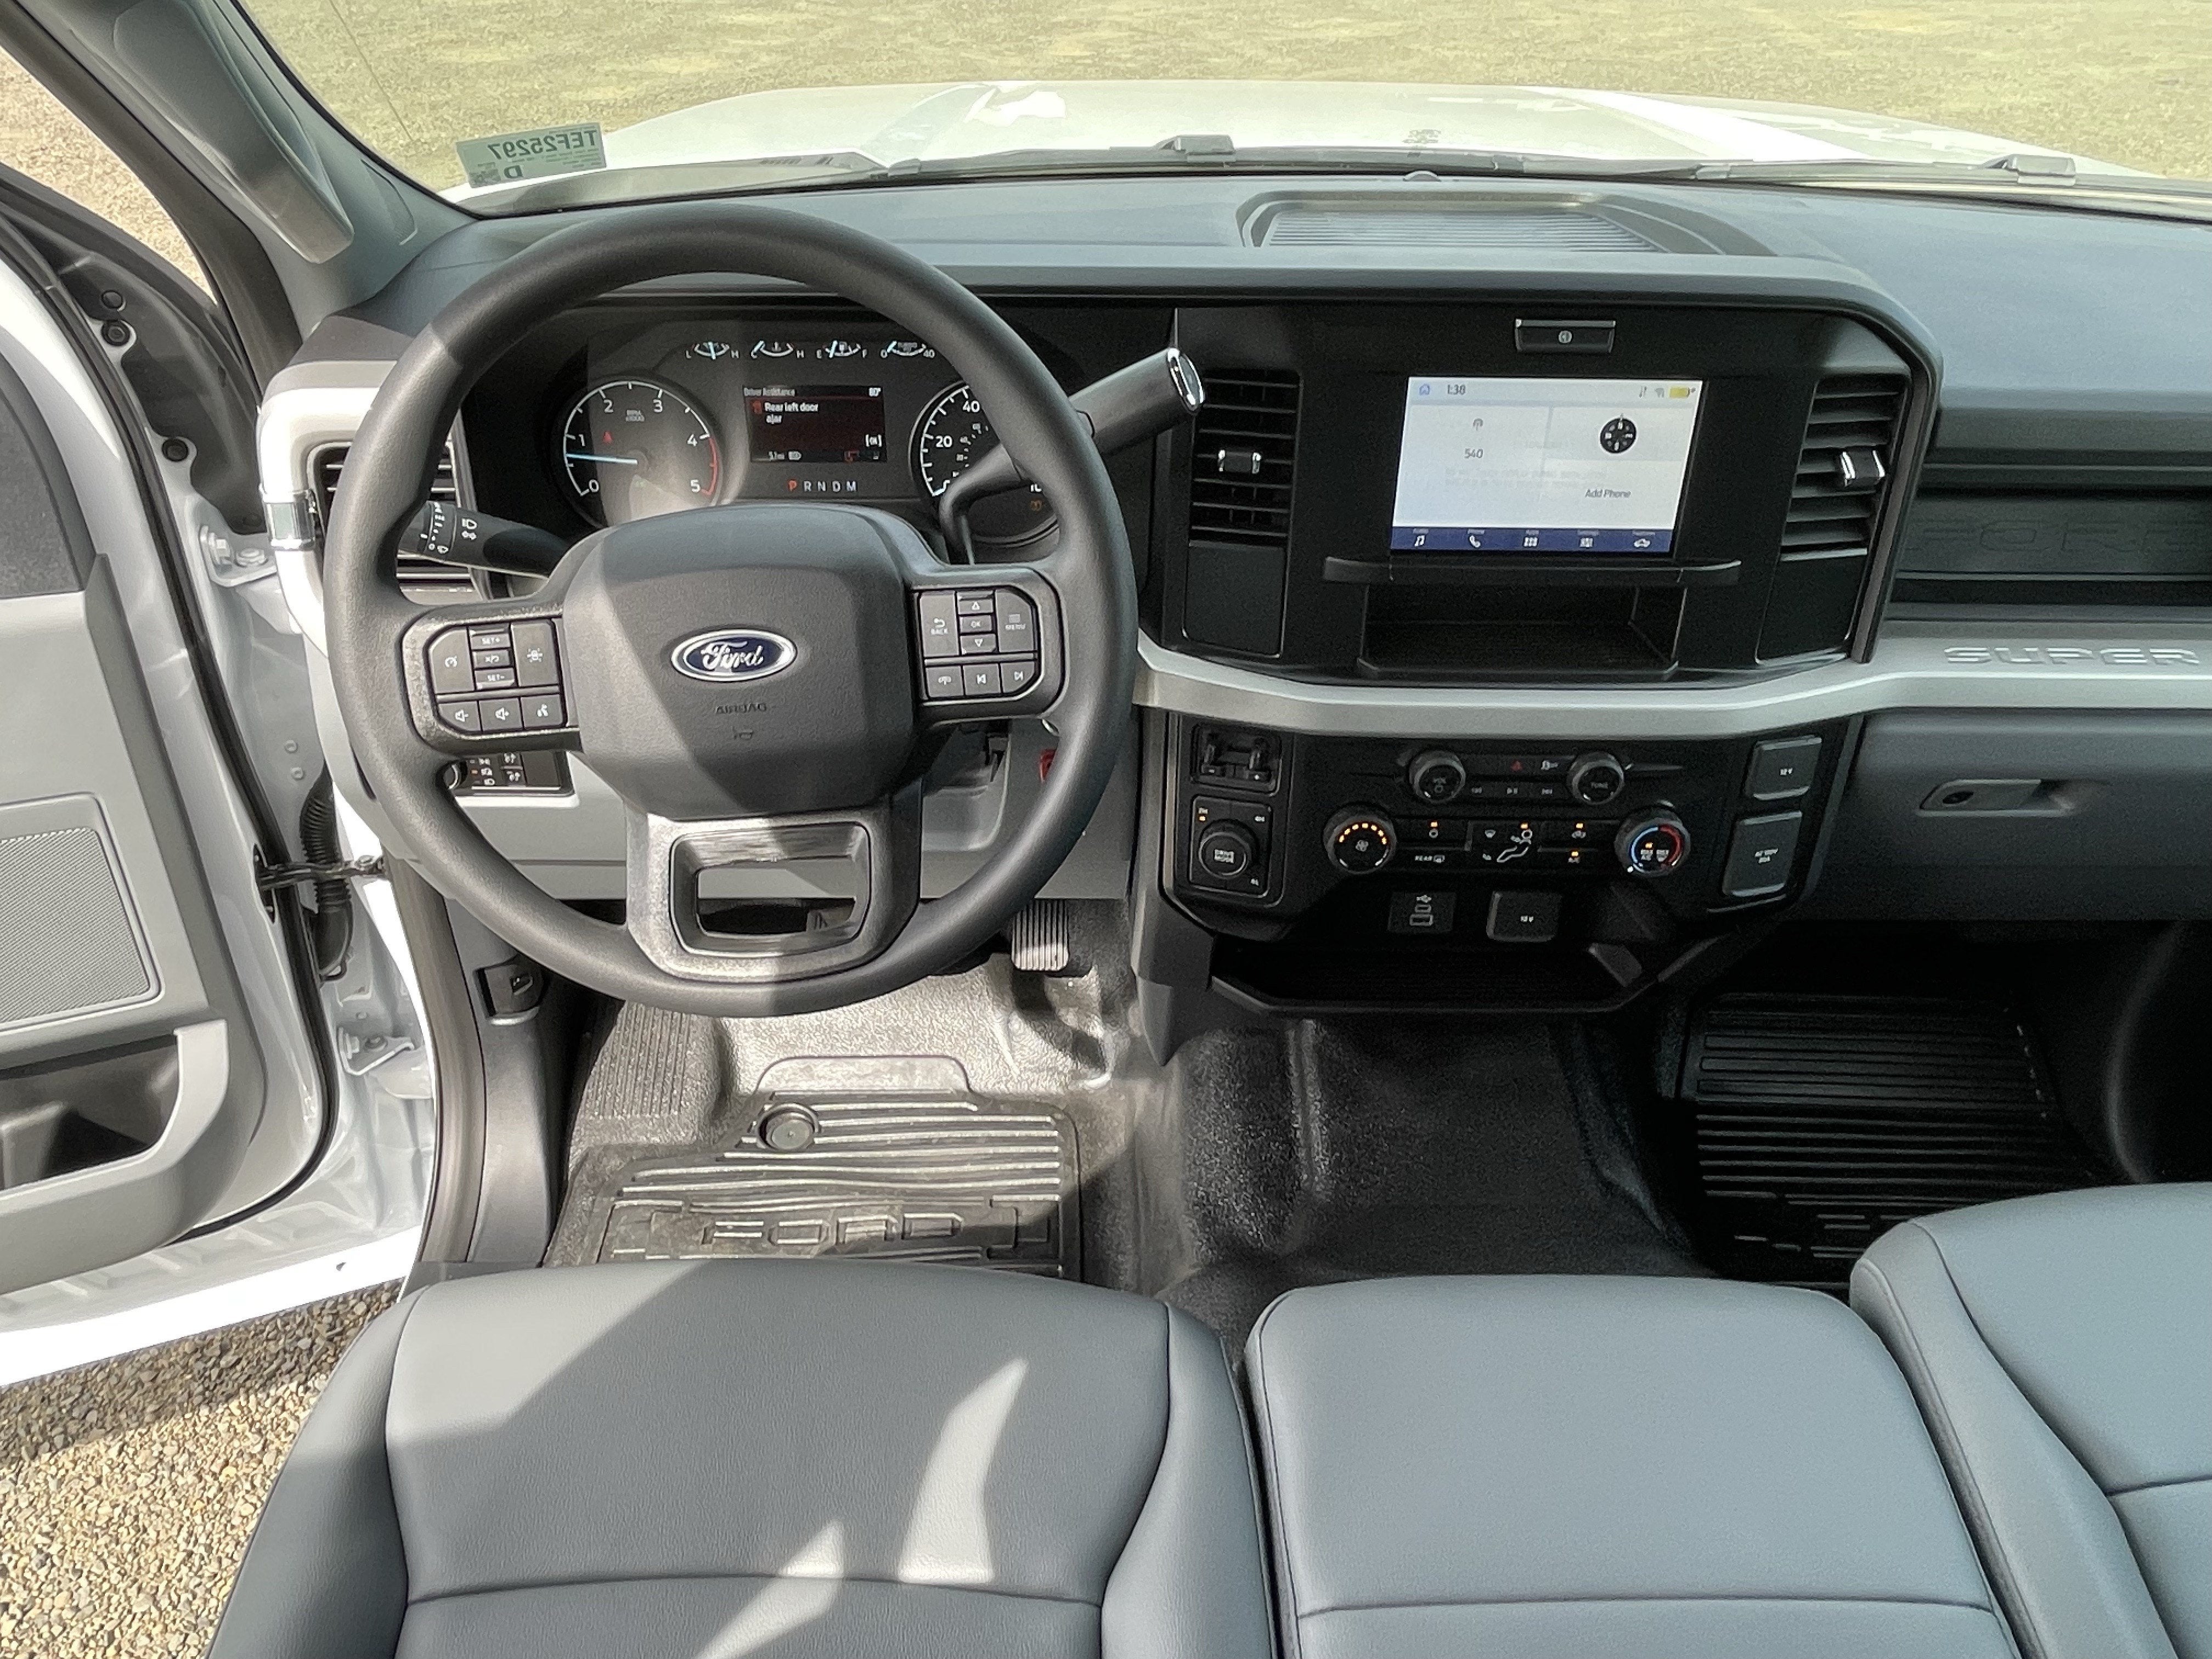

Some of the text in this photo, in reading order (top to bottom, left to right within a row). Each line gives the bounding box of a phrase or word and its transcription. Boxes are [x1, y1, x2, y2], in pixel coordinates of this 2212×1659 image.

[686, 350, 691, 359] L
[731, 350, 740, 359] H
[797, 350, 805, 359] H
[603, 399, 613, 413] 2
[653, 399, 663, 413] 3
[765, 402, 819, 411] Rear left door
[962, 400, 980, 413] 40
[766, 414, 782, 425] ajar
[578, 434, 585, 447] 1
[687, 433, 698, 447] 4
[935, 436, 952, 448] 20
[1464, 449, 1483, 459] 540
[588, 479, 599, 492] 0
[690, 479, 701, 492] 5
[788, 481, 857, 492] P R N D M
[1584, 489, 1631, 499] Add Phone
[701, 641, 764, 671] Ford
[1943, 647, 2200, 665] SUPER
